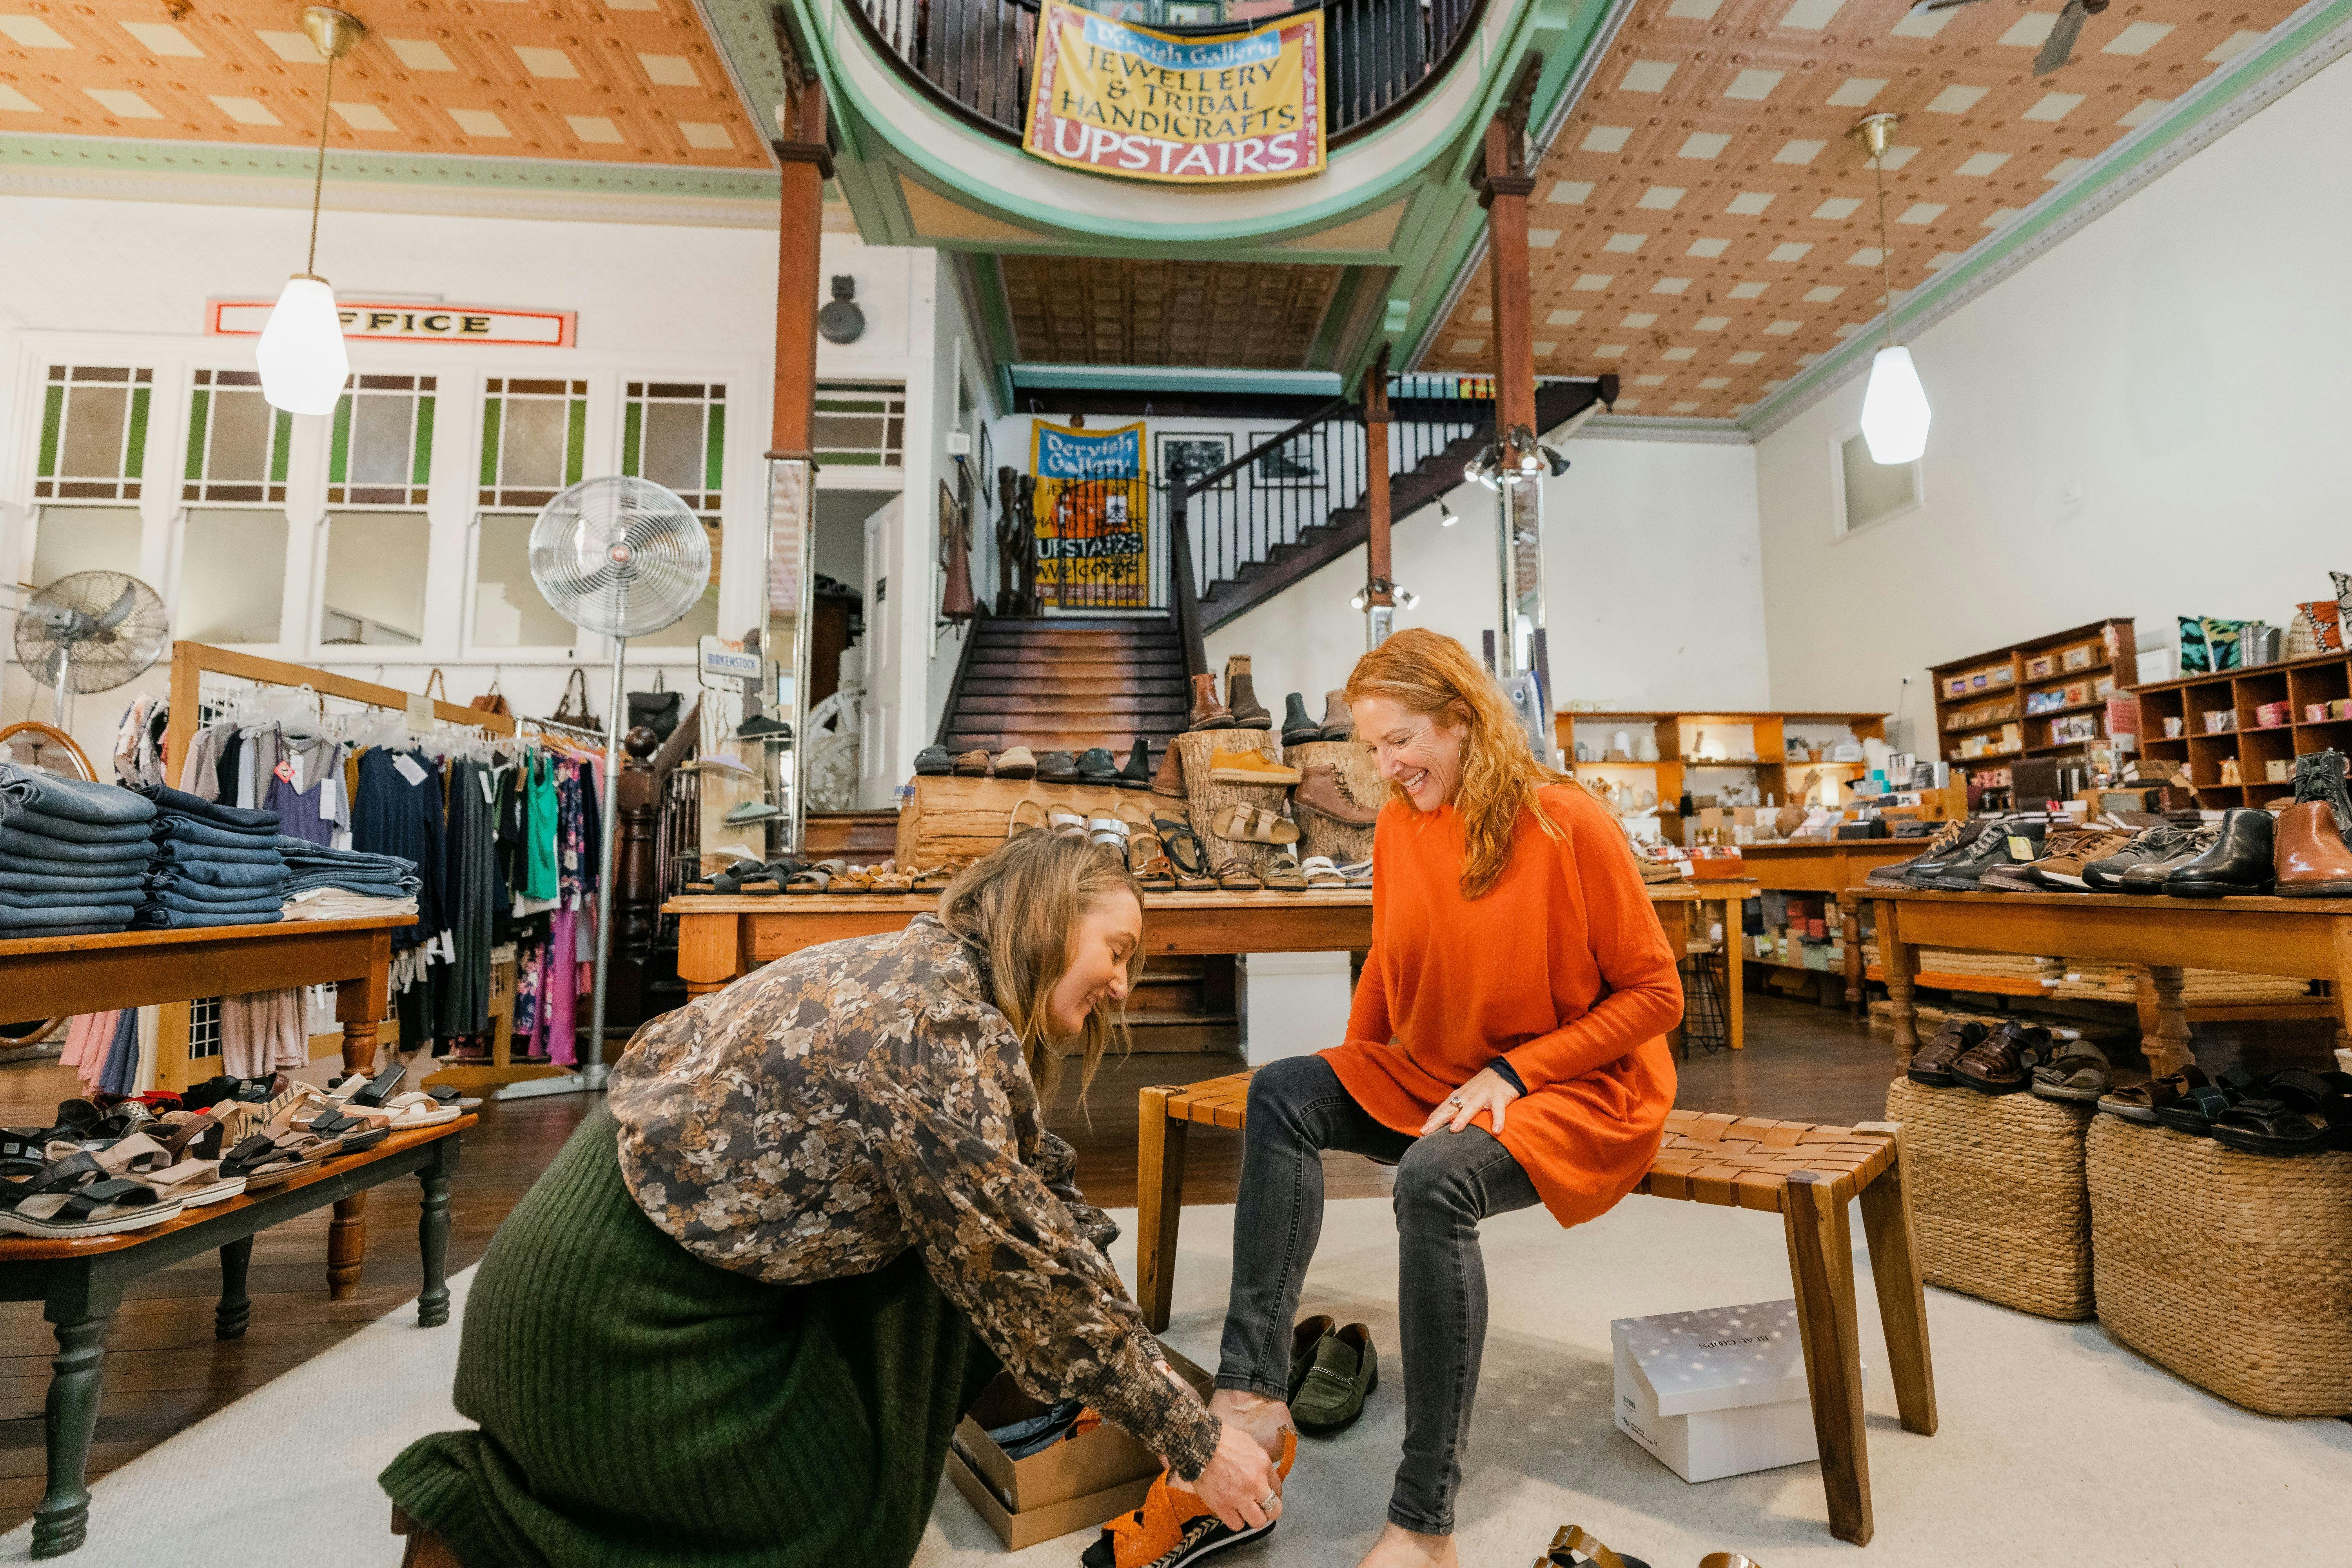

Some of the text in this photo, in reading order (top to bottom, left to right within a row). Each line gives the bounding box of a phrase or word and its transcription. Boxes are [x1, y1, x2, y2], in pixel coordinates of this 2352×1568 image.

[1098, 20, 1272, 65] Dervish Gallery
[1087, 46, 1279, 92] JEWELLERY
[1062, 89, 1295, 138] HANDICRAFTS
[1107, 80, 1256, 115] & TRIBAL
[1054, 117, 1298, 176] UPSTAIRS
[338, 312, 490, 334] FFICE
[1048, 434, 1132, 457] Dervish
[1048, 452, 1131, 474] Gallery
[708, 653, 755, 669] BIRKENSTOCK
